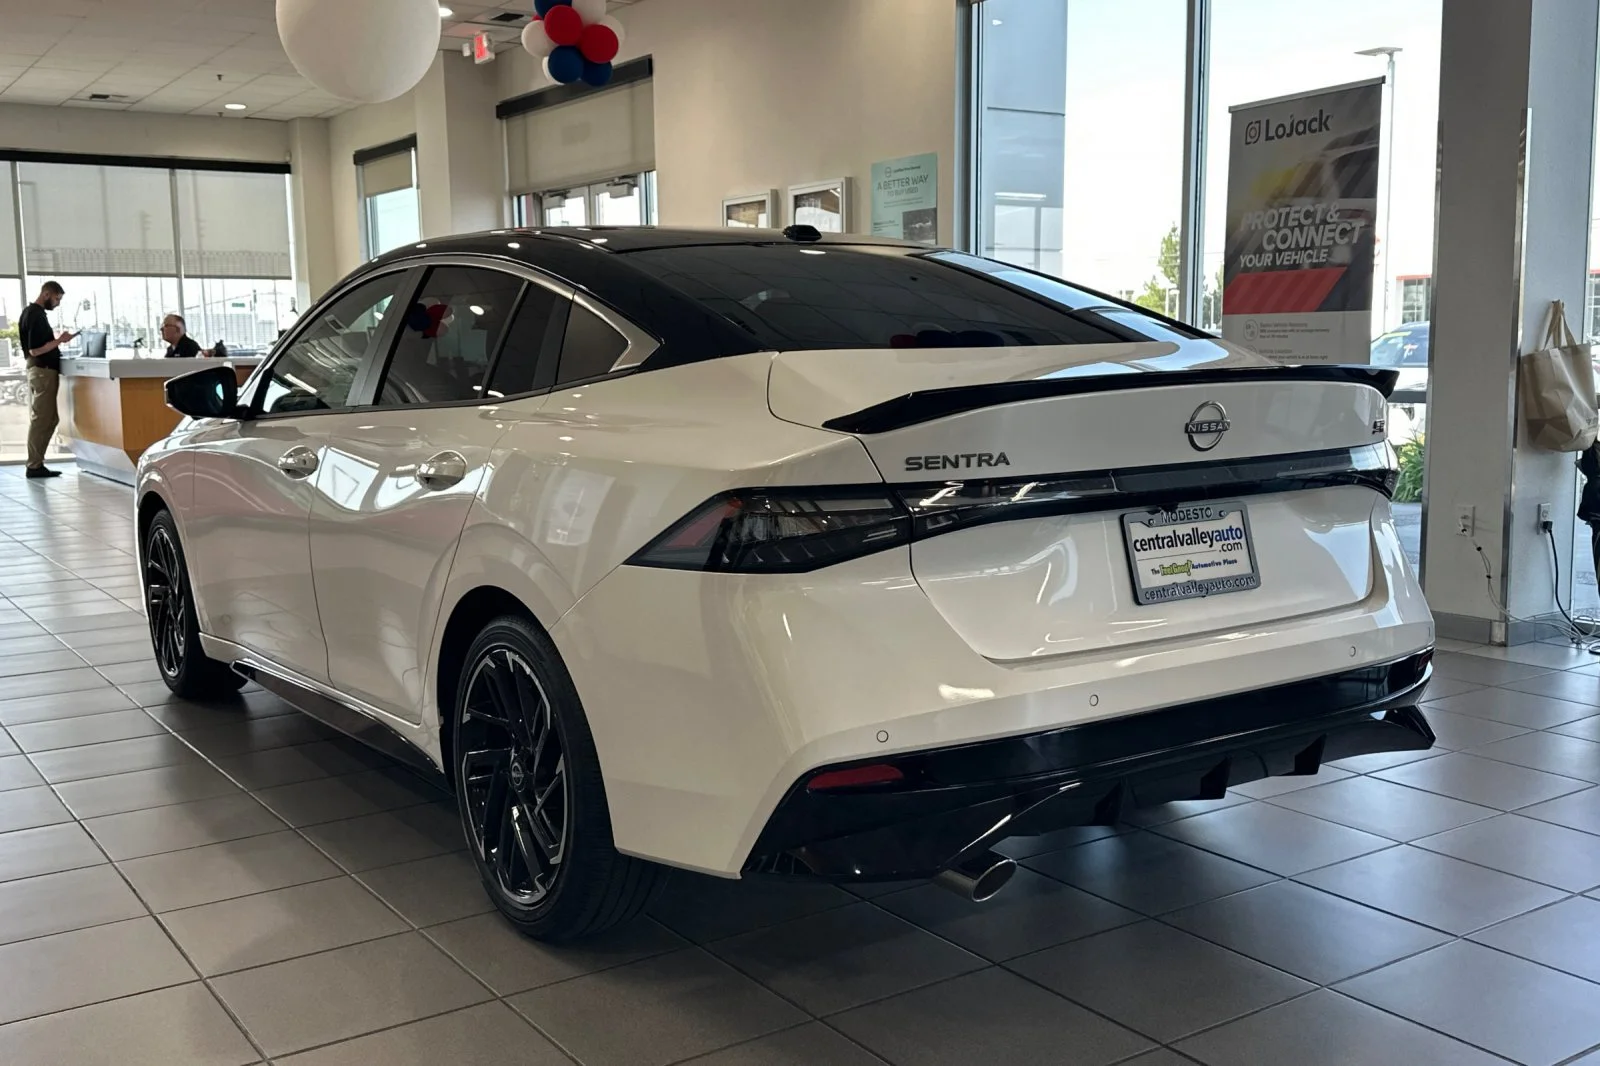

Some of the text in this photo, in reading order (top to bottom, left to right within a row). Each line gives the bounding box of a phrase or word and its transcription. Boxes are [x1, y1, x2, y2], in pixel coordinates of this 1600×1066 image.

[877, 174, 929, 192] A BETTER WAY
[1240, 202, 1341, 231] PROTECT &
[1262, 219, 1366, 251] CONNECT
[1239, 249, 1329, 268] YOUR VEHICLE
[1188, 422, 1229, 432] NISSAN
[905, 451, 1011, 471] SENTRA
[1160, 507, 1214, 524] MODESTO
[1133, 525, 1243, 552] centralvalleyauto
[1144, 574, 1256, 601] centralvalleyauto.com
